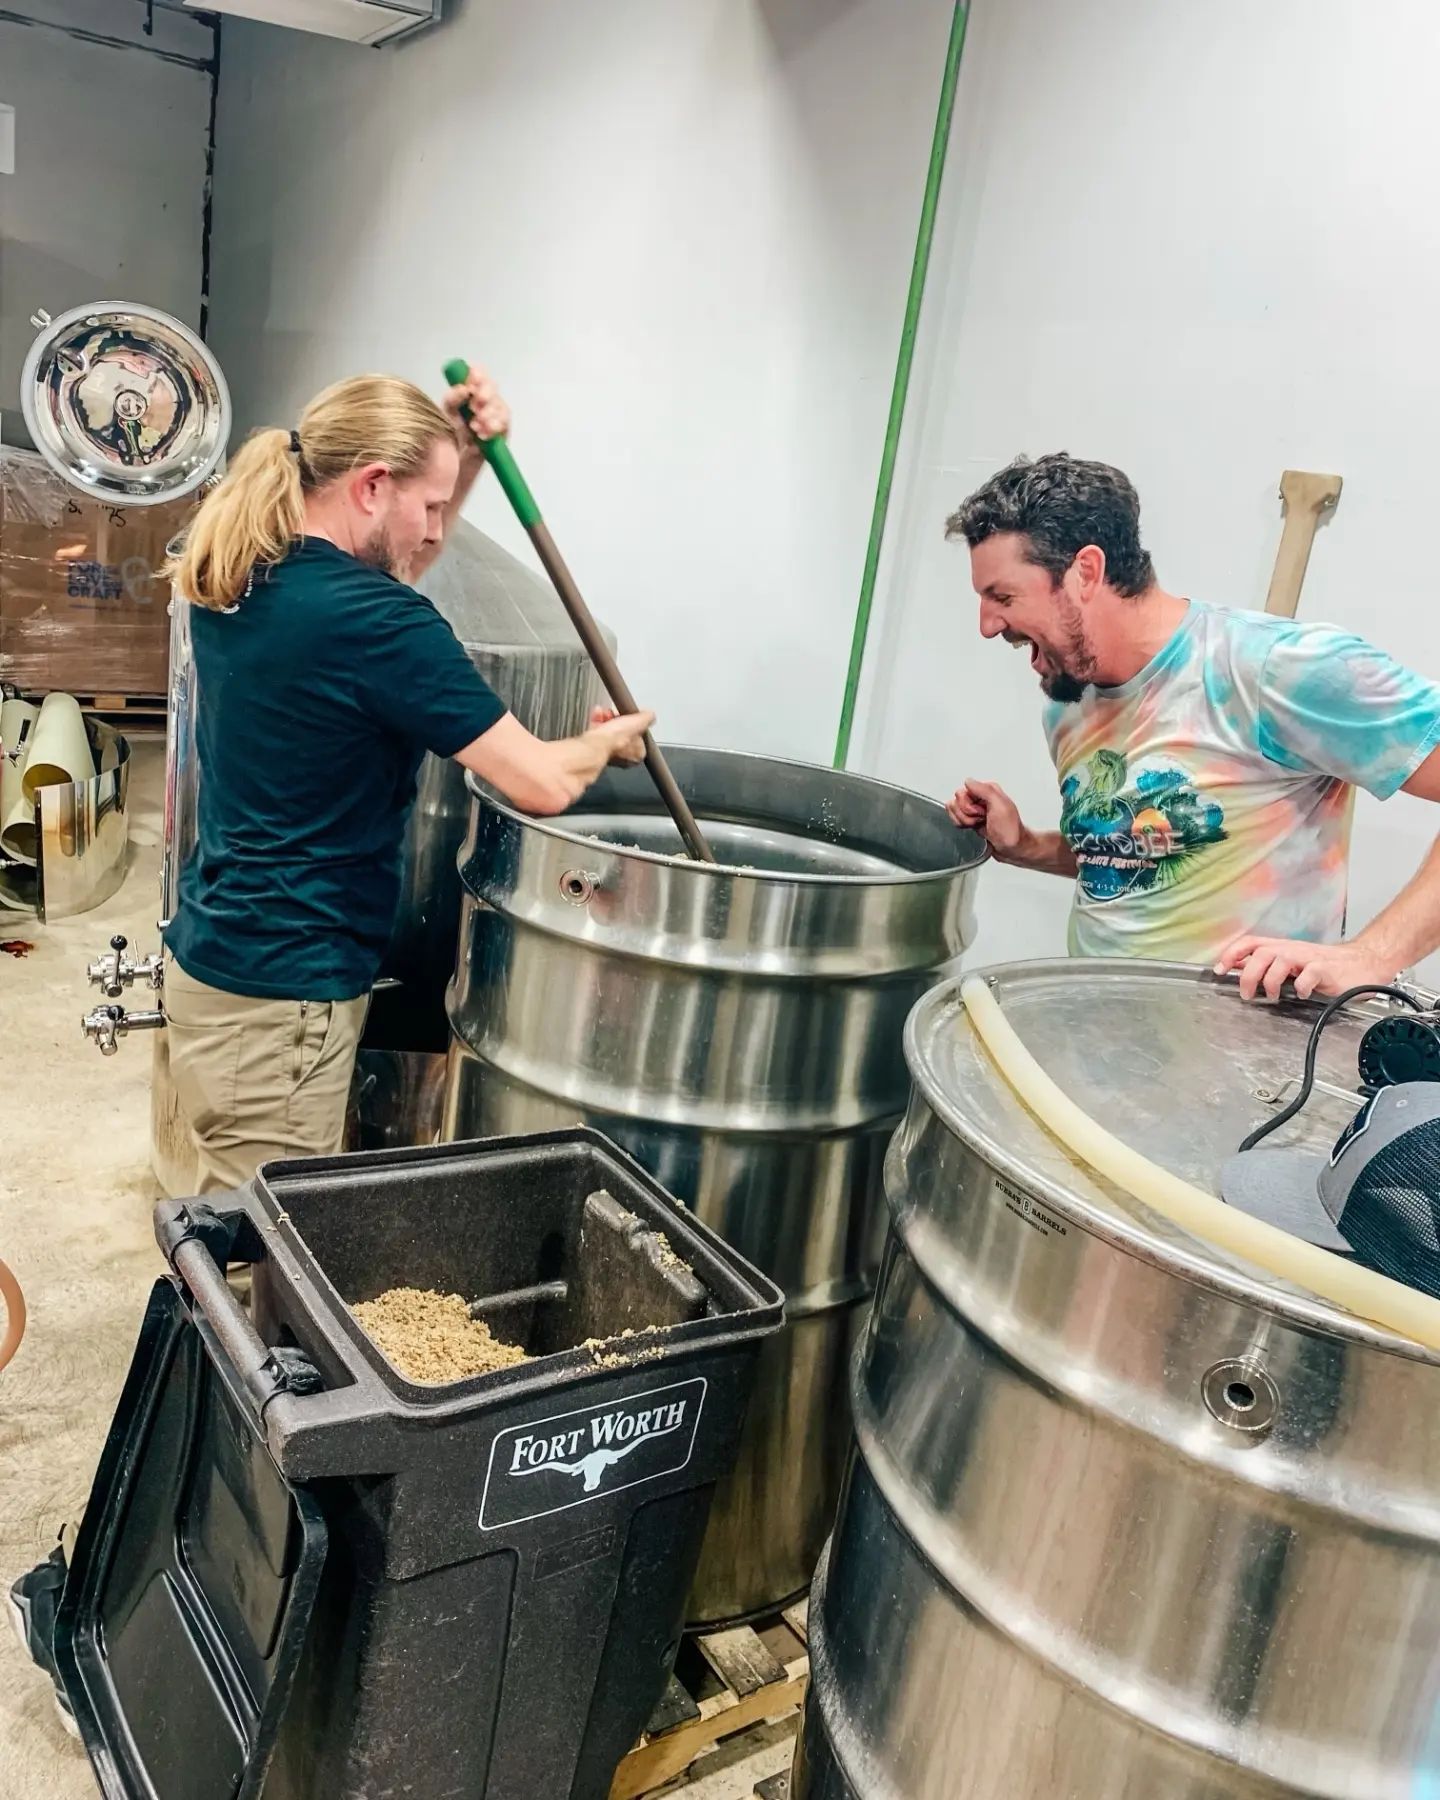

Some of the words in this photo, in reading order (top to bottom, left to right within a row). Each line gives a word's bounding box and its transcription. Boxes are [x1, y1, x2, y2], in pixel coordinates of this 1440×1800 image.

[67, 586, 122, 600] CRAFT
[1031, 1207, 1067, 1236] BARRELS
[510, 1428, 585, 1472] FORT
[590, 1400, 686, 1447] WORTH
